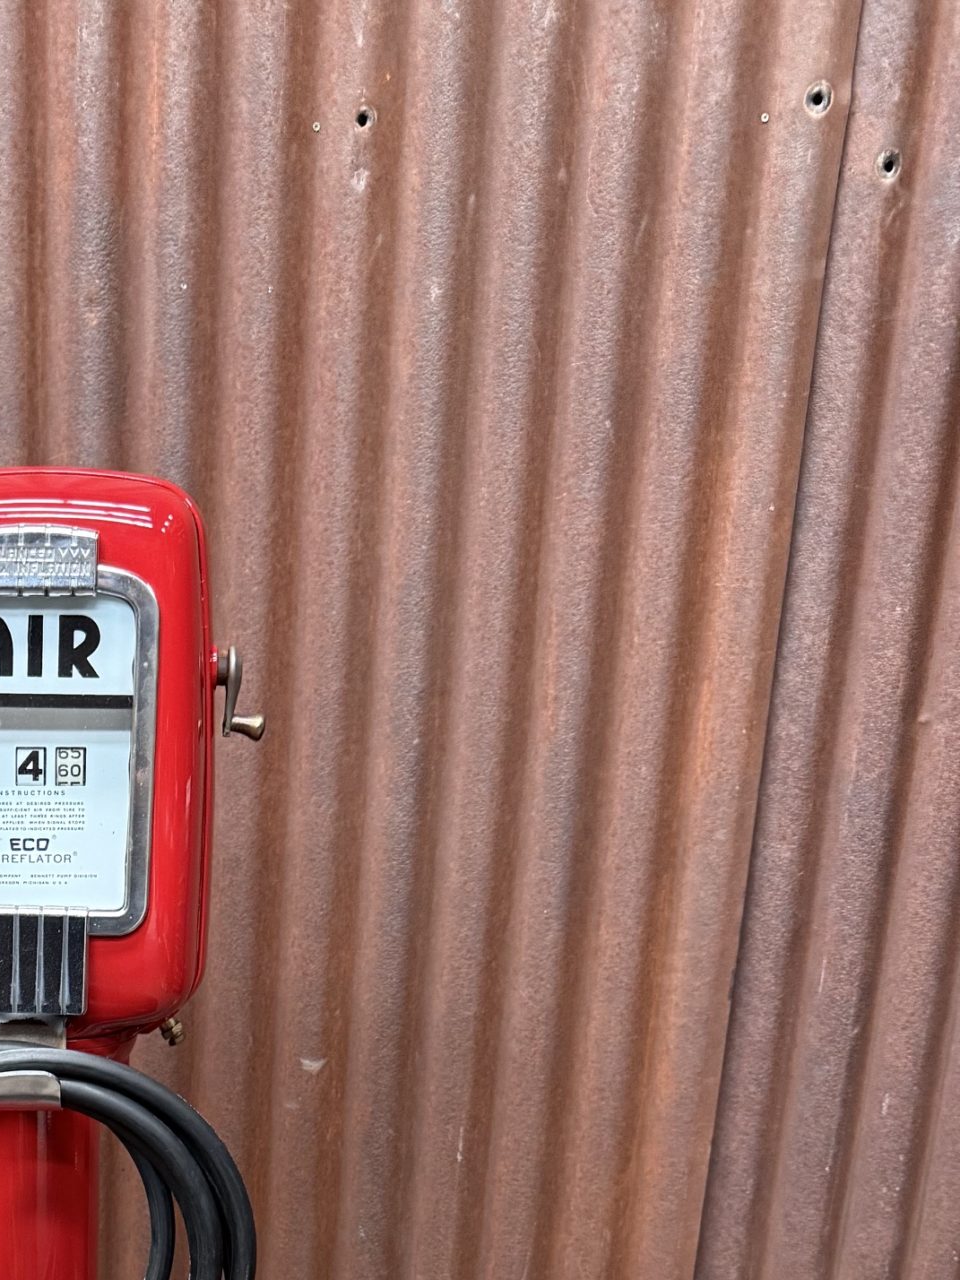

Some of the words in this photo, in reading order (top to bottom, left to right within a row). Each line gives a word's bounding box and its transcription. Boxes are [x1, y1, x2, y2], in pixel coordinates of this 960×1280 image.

[13, 561, 91, 576] INFLATION
[58, 749, 81, 760] 65
[18, 751, 43, 781] 4
[58, 764, 81, 777] 60
[9, 838, 50, 851] ECO
